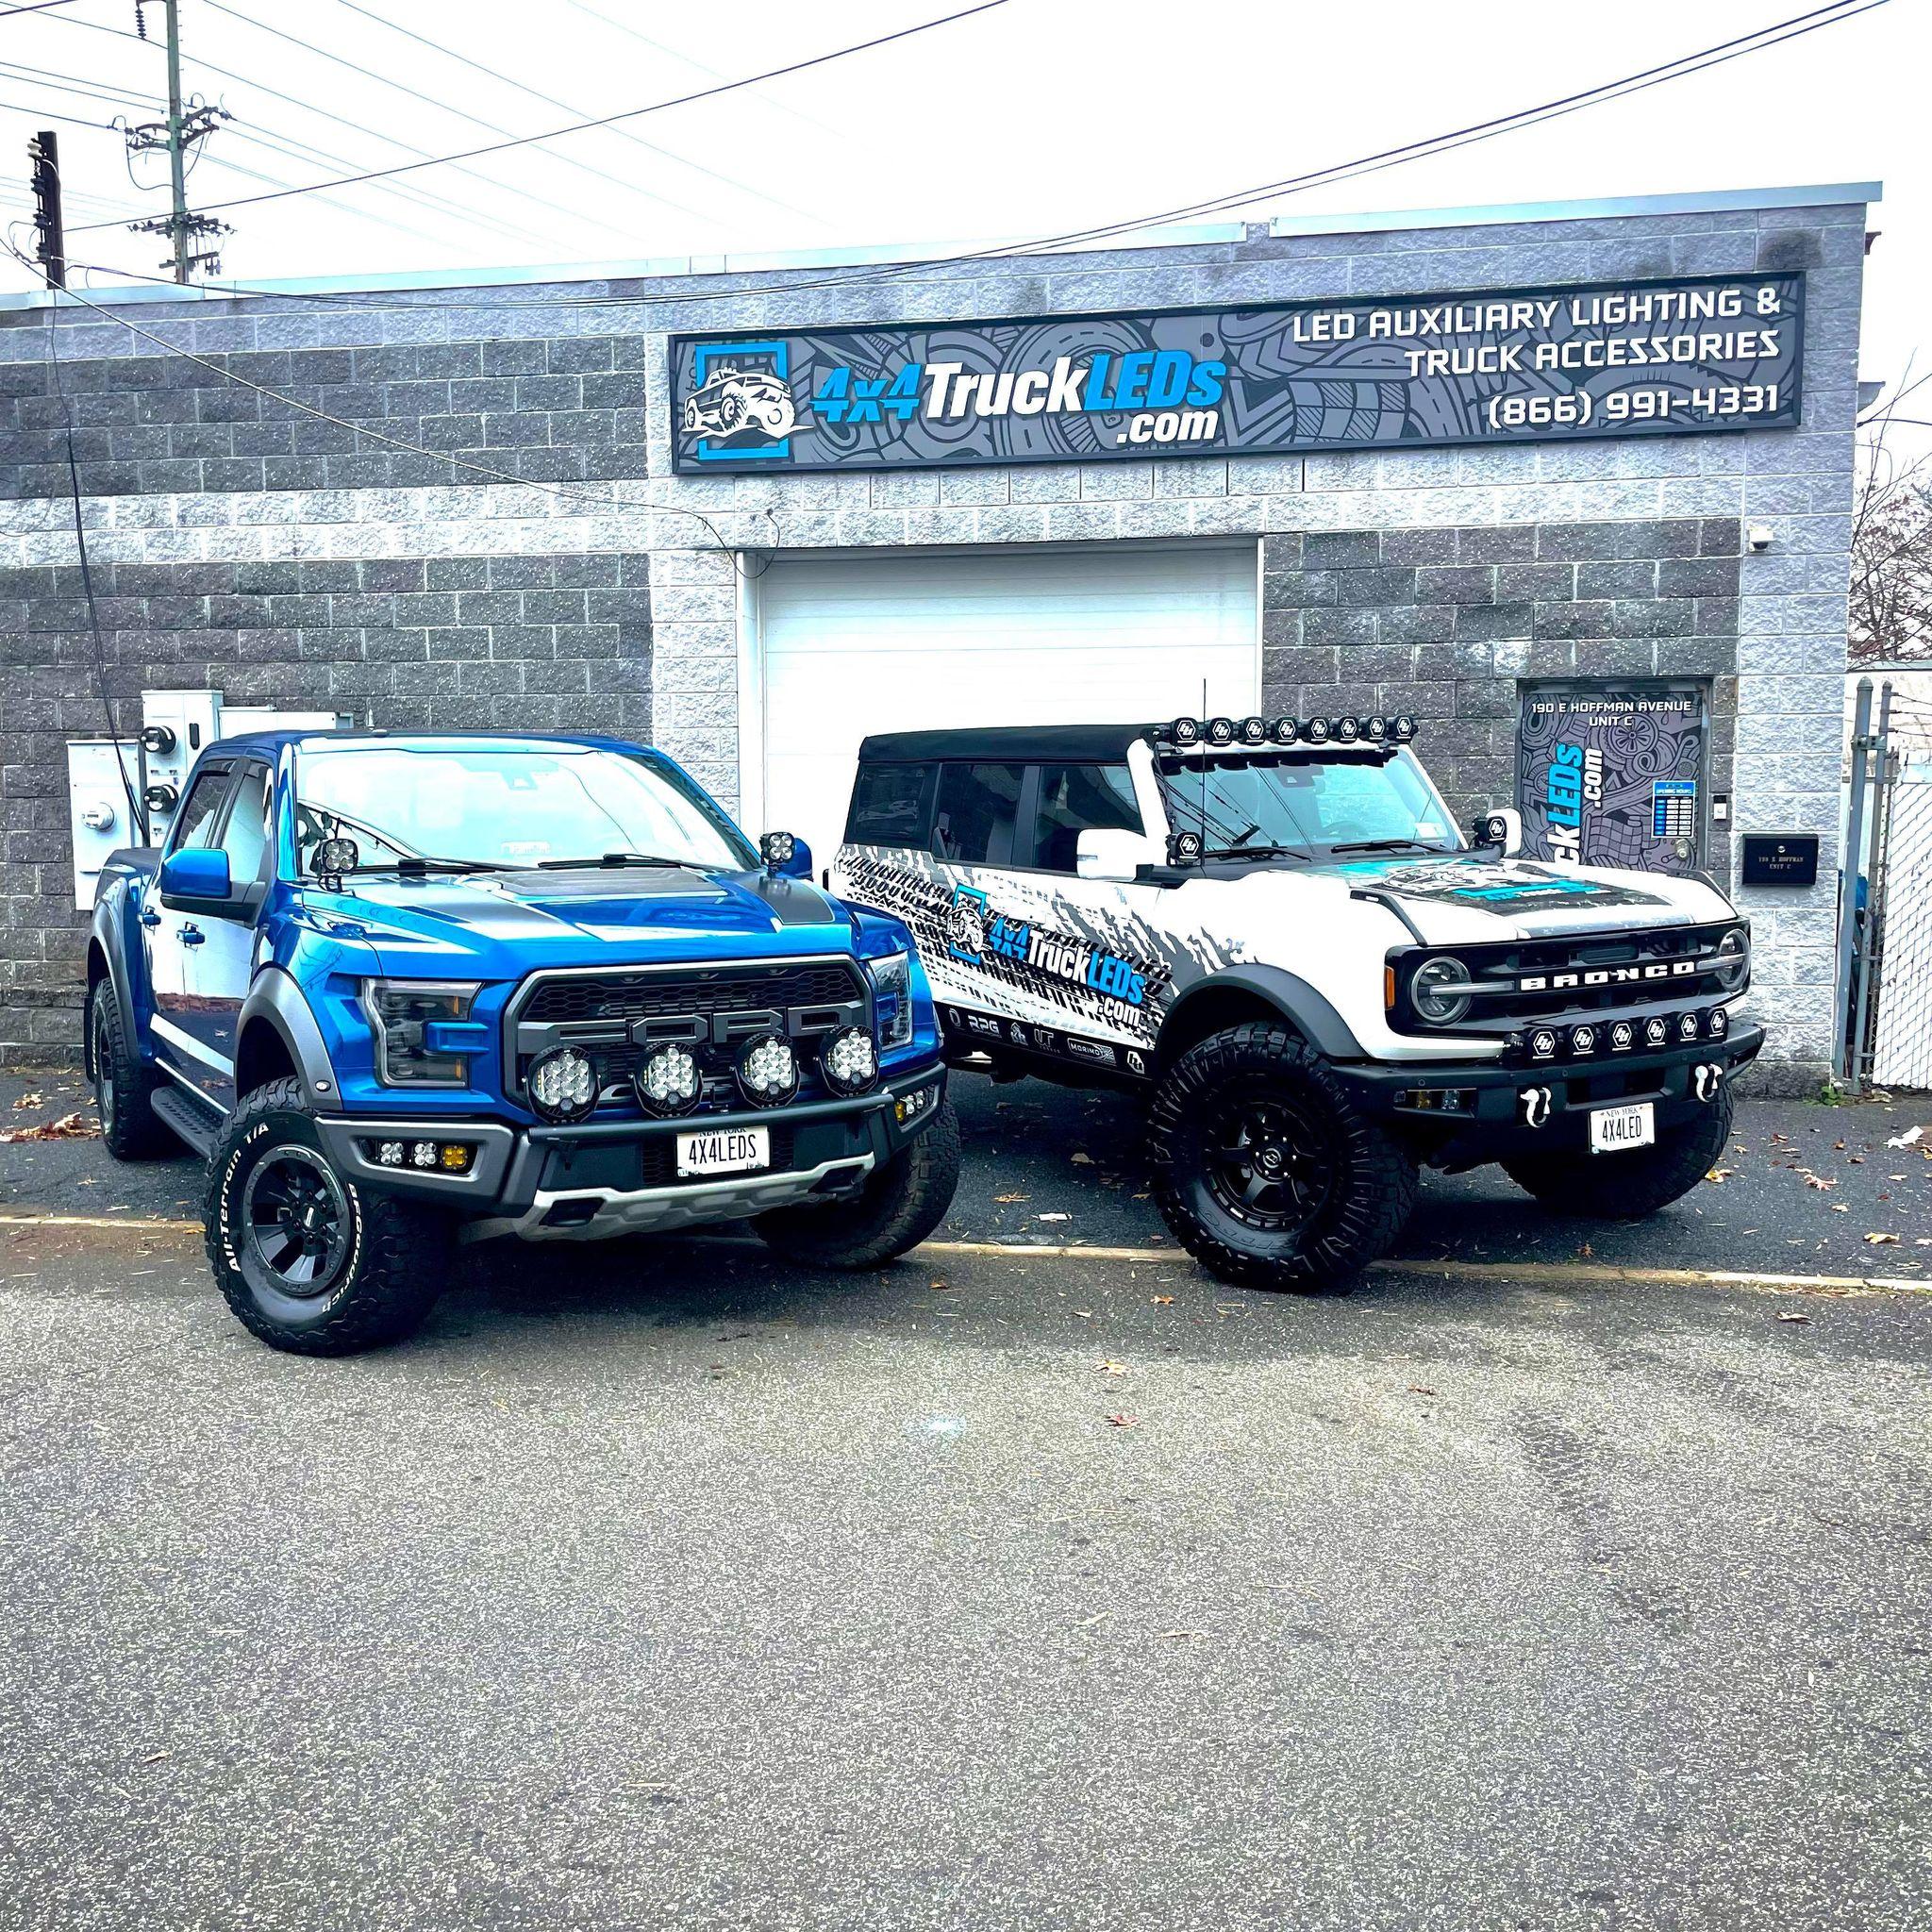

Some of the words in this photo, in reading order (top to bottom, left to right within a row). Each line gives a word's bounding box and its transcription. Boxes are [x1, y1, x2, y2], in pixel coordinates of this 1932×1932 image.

[1292, 312, 1356, 343] LED
[1368, 299, 1559, 339] AUXILIARY
[1571, 289, 1742, 327] LIGHTING
[1757, 287, 1782, 316] &
[1404, 343, 1524, 377] TRUCK
[1534, 329, 1780, 371] ACCESSORIES
[1489, 390, 1592, 430] (866)
[1606, 384, 1778, 421] 991-4331
[1116, 409, 1219, 444] .com
[1531, 703, 1555, 713] 190
[1558, 702, 1567, 713] E
[1570, 702, 1634, 713] HOFFMAN
[1638, 701, 1691, 712] AVENUE
[1589, 716, 1620, 726] UNIT
[1624, 716, 1633, 726] C
[1583, 748, 1603, 808] .com
[1520, 961, 1694, 991] BRONCO
[968, 1014, 1000, 1034] RPG
[1602, 1115, 1642, 1142] 4X4LED
[689, 1134, 757, 1165] 4X4LEDS
